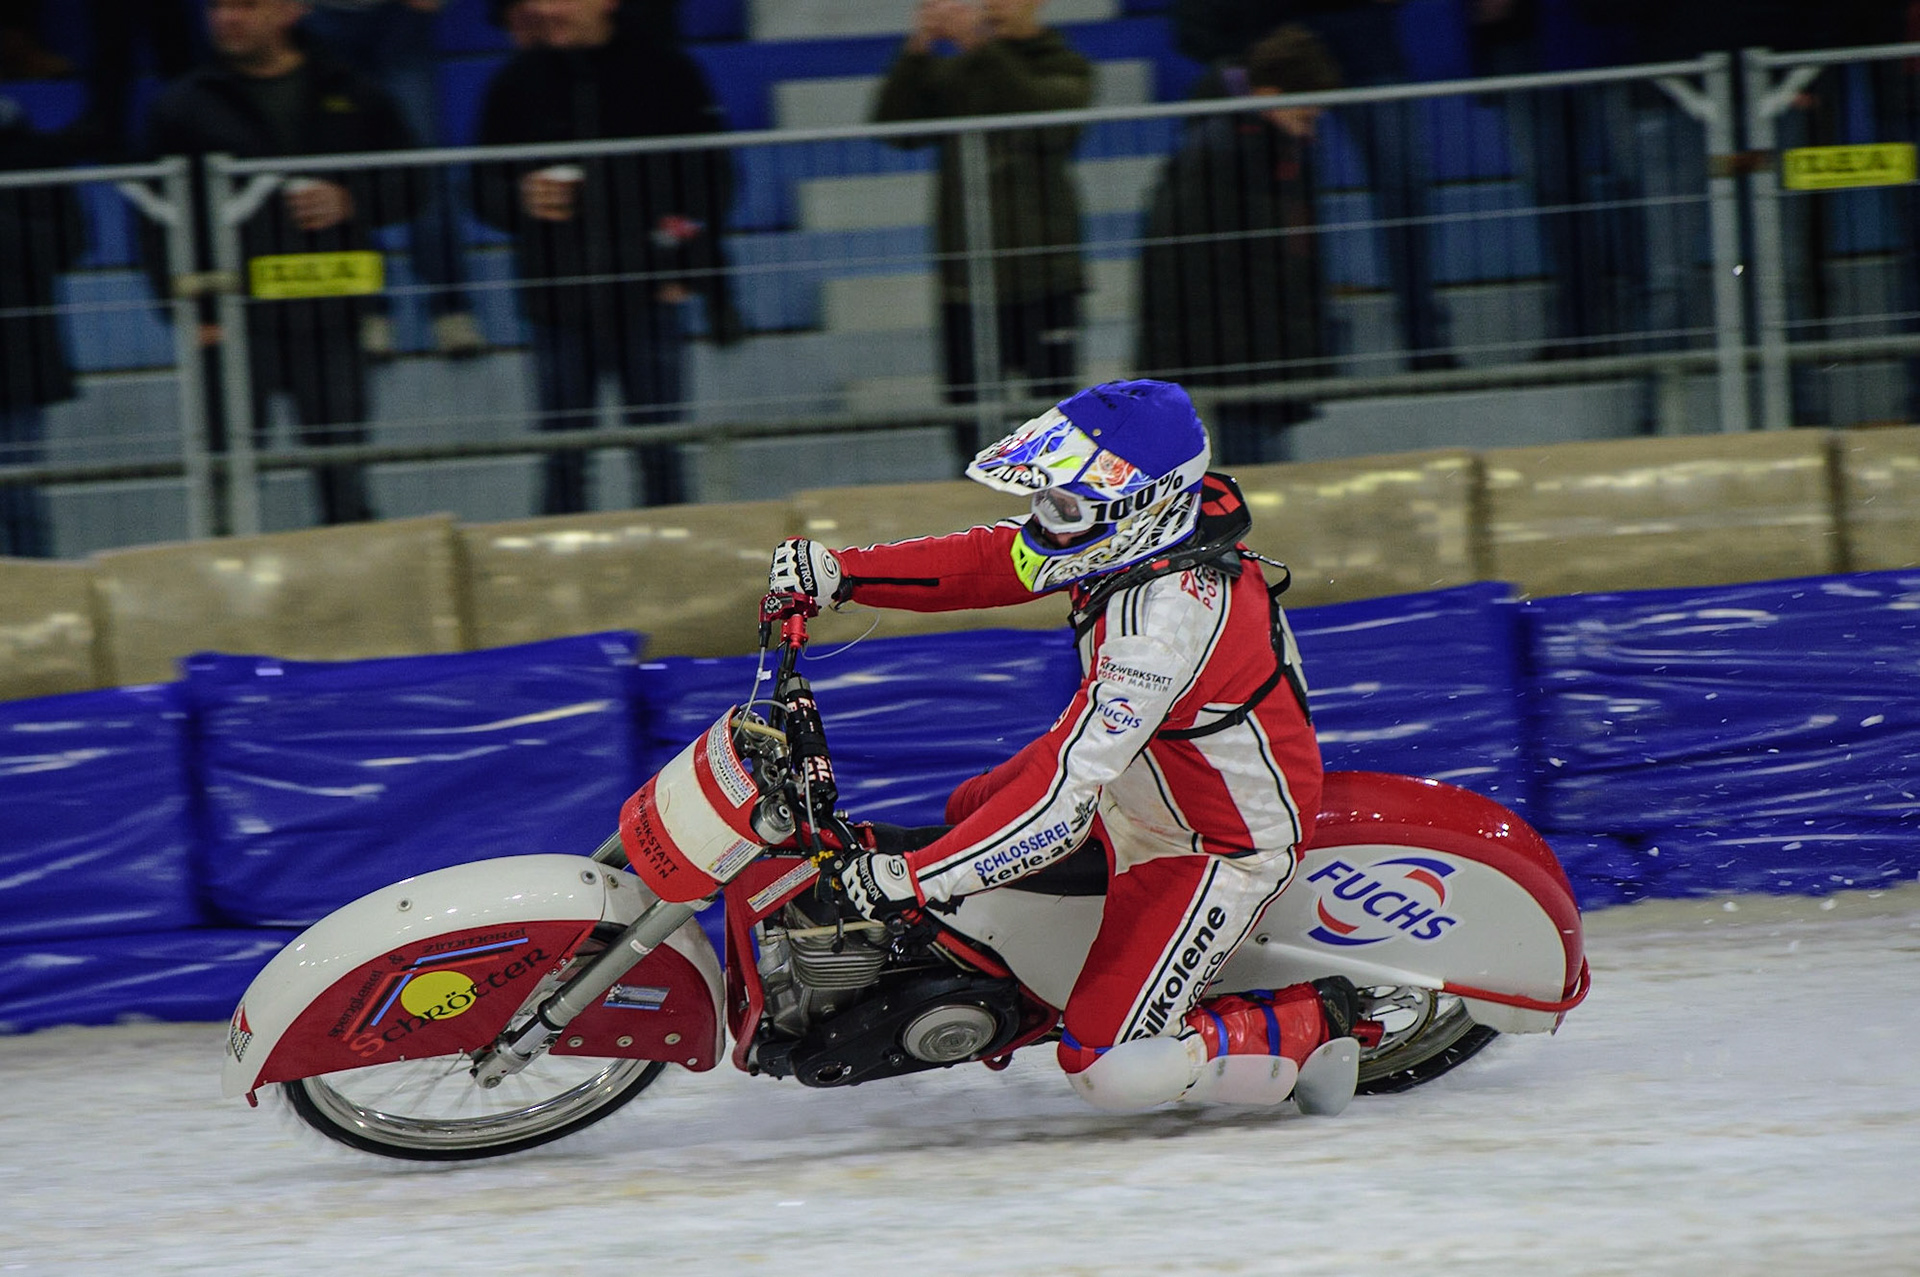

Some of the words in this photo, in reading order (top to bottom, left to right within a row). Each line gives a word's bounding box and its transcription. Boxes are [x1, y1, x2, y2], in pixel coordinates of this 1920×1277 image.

[1090, 471, 1183, 522] 100%
[1127, 679, 1170, 693] MARTIN
[1097, 703, 1143, 729] FUCHS
[635, 826, 669, 879] MARTIN
[974, 821, 1070, 877] SCHLOSSEREI
[980, 837, 1074, 887] kerle.at
[1306, 860, 1457, 940] FUCHS
[1131, 906, 1226, 1041] Silkolene
